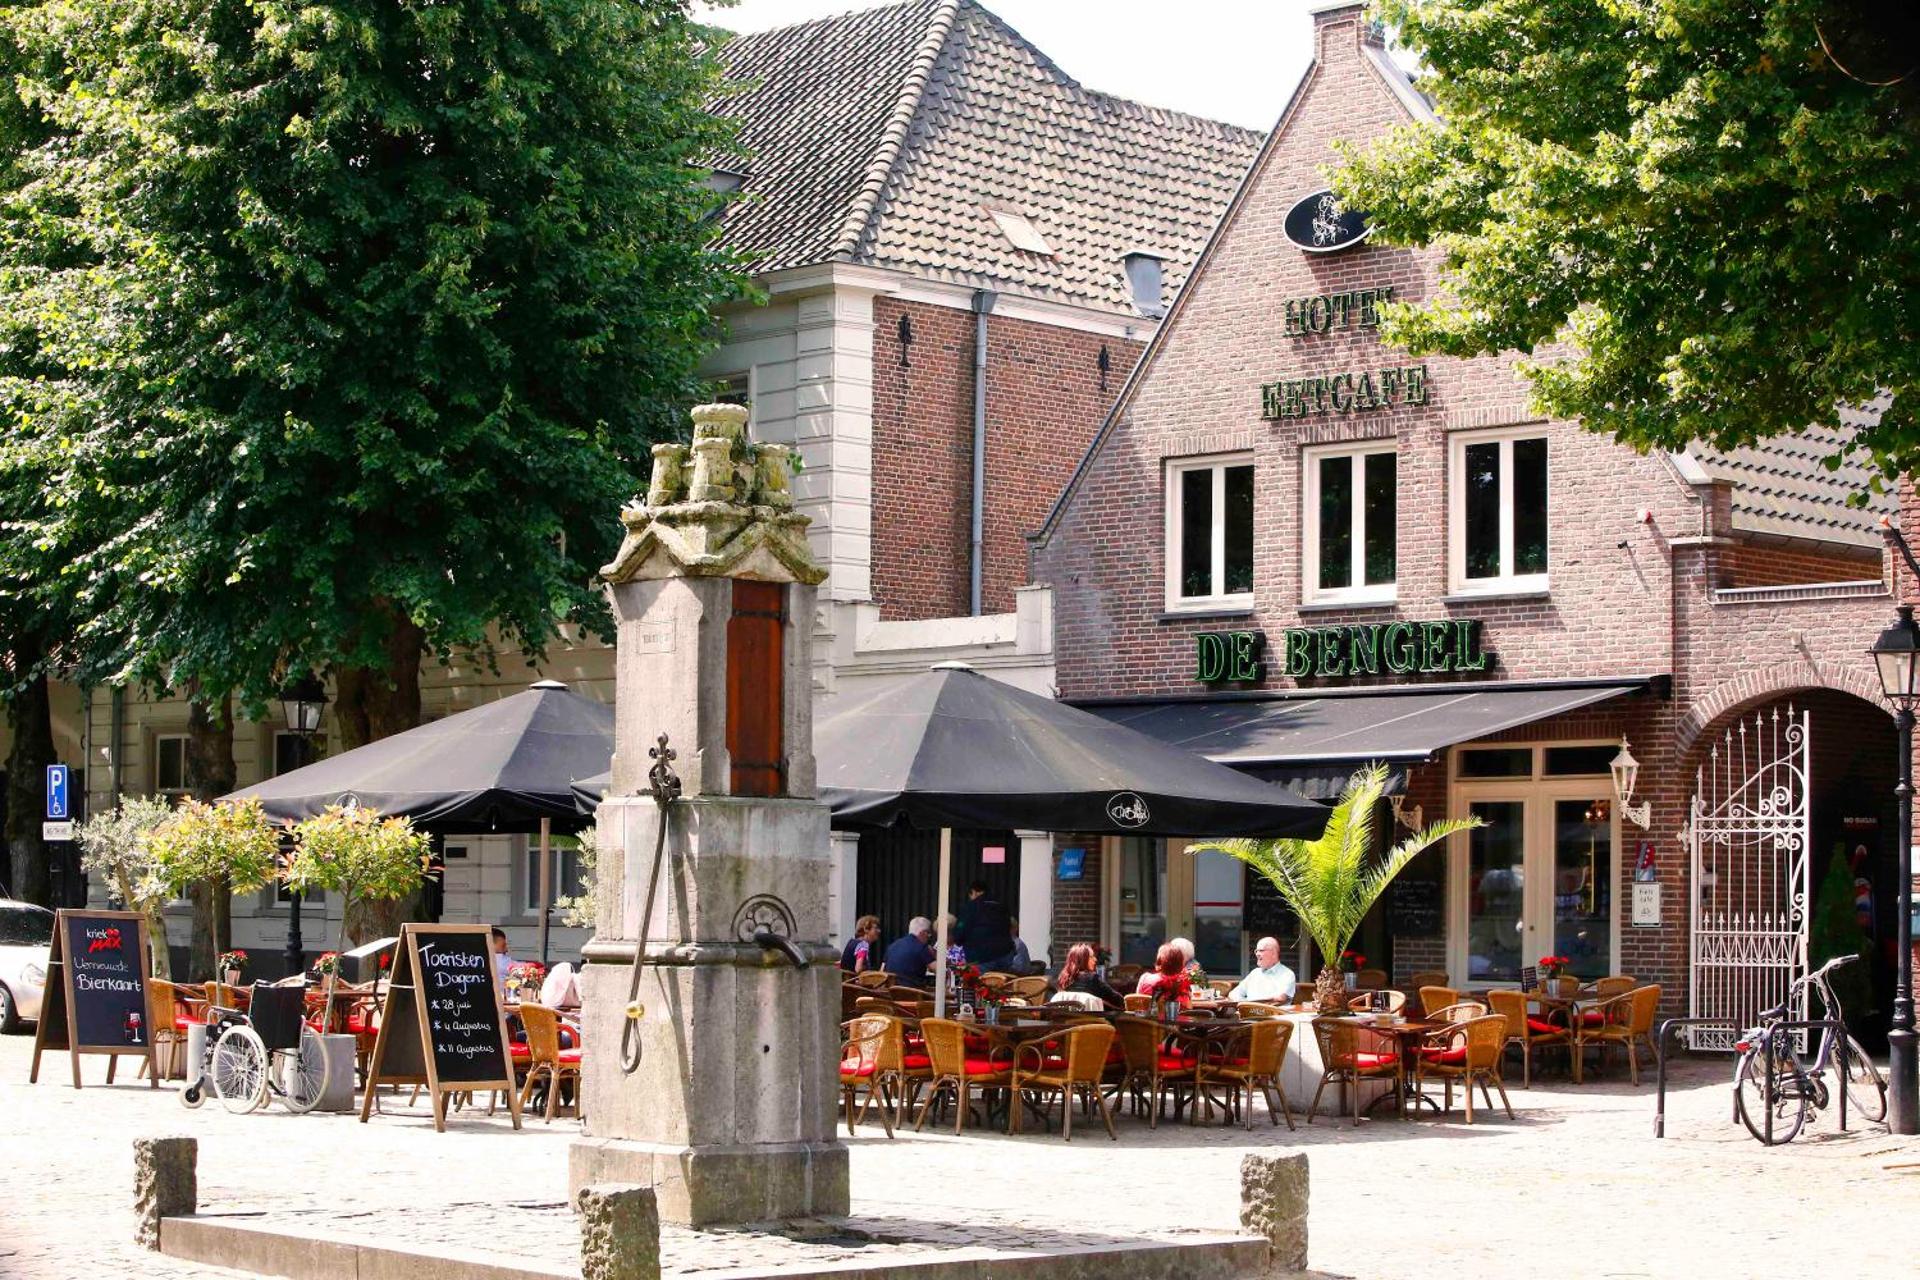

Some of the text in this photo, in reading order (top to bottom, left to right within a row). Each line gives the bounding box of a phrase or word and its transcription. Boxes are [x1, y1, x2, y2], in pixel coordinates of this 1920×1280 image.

[1261, 365, 1429, 420] EETCAFE
[1194, 619, 1488, 682] DE BENGEL
[51, 769, 62, 796] P
[86, 928, 107, 939] kriek
[418, 941, 485, 968] Toeristen
[77, 973, 142, 993] Bierkaart
[434, 971, 486, 995] Dagen:
[442, 999, 472, 1016] 28 juli
